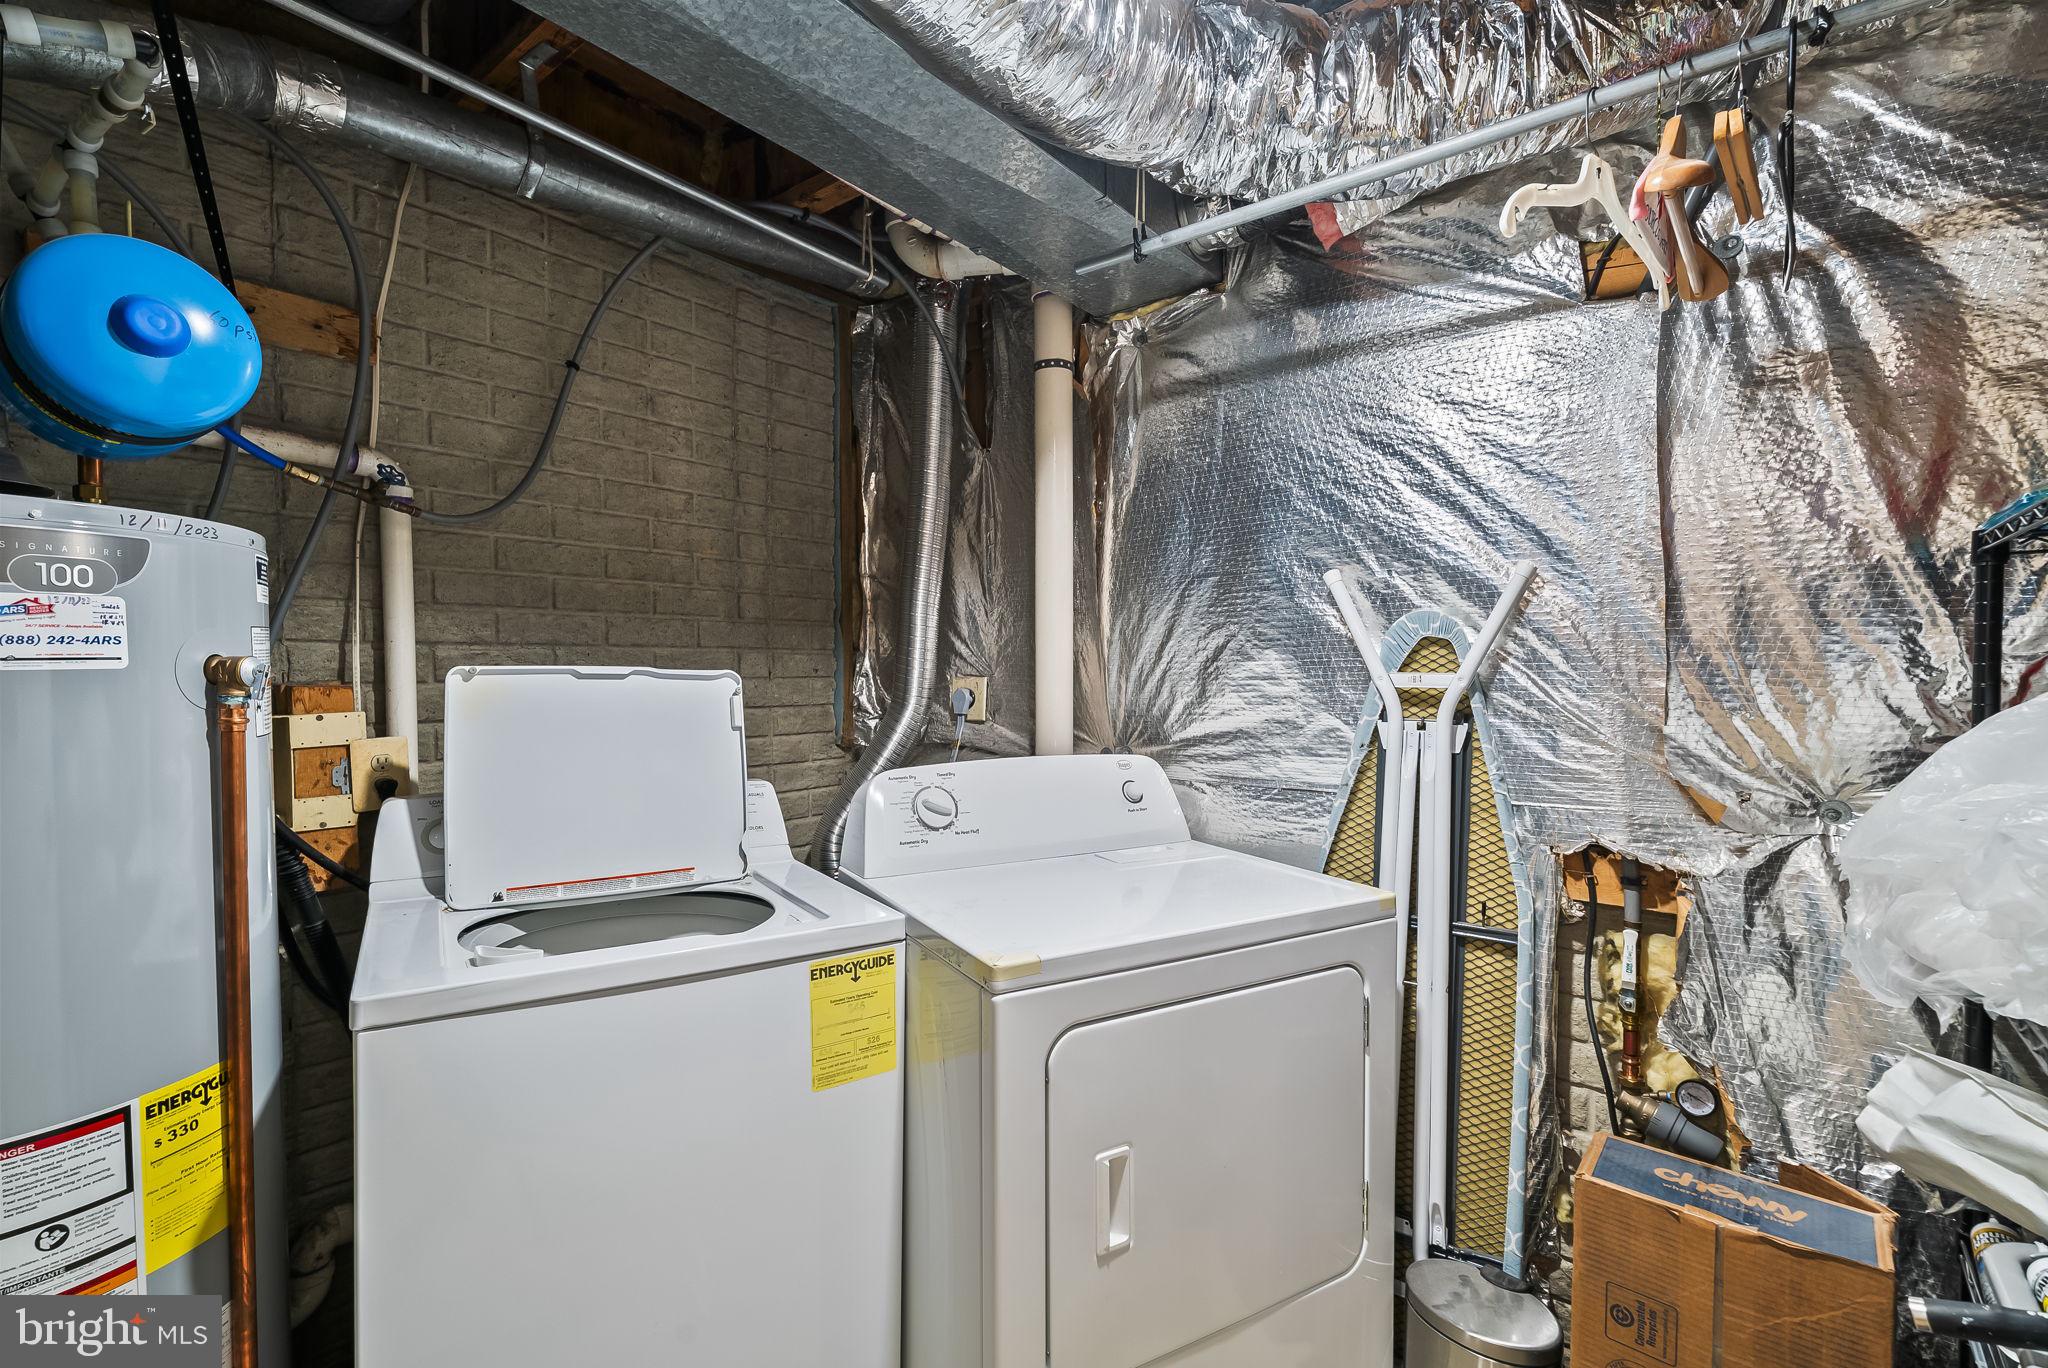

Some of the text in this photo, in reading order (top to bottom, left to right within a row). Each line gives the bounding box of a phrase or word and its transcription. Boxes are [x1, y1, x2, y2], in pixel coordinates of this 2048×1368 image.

[34, 562, 94, 589] 100
[2, 605, 25, 615] ARS
[0, 634, 122, 646] (888) 242-4ARS
[810, 954, 895, 983] ENERGYGUIDE
[167, 1119, 200, 1143] 330
[1654, 1167, 1808, 1222] chewy
[1662, 1182, 1698, 1197] where
[1635, 1300, 1646, 1347] Corrugated
[1646, 1308, 1658, 1348] Recycles
